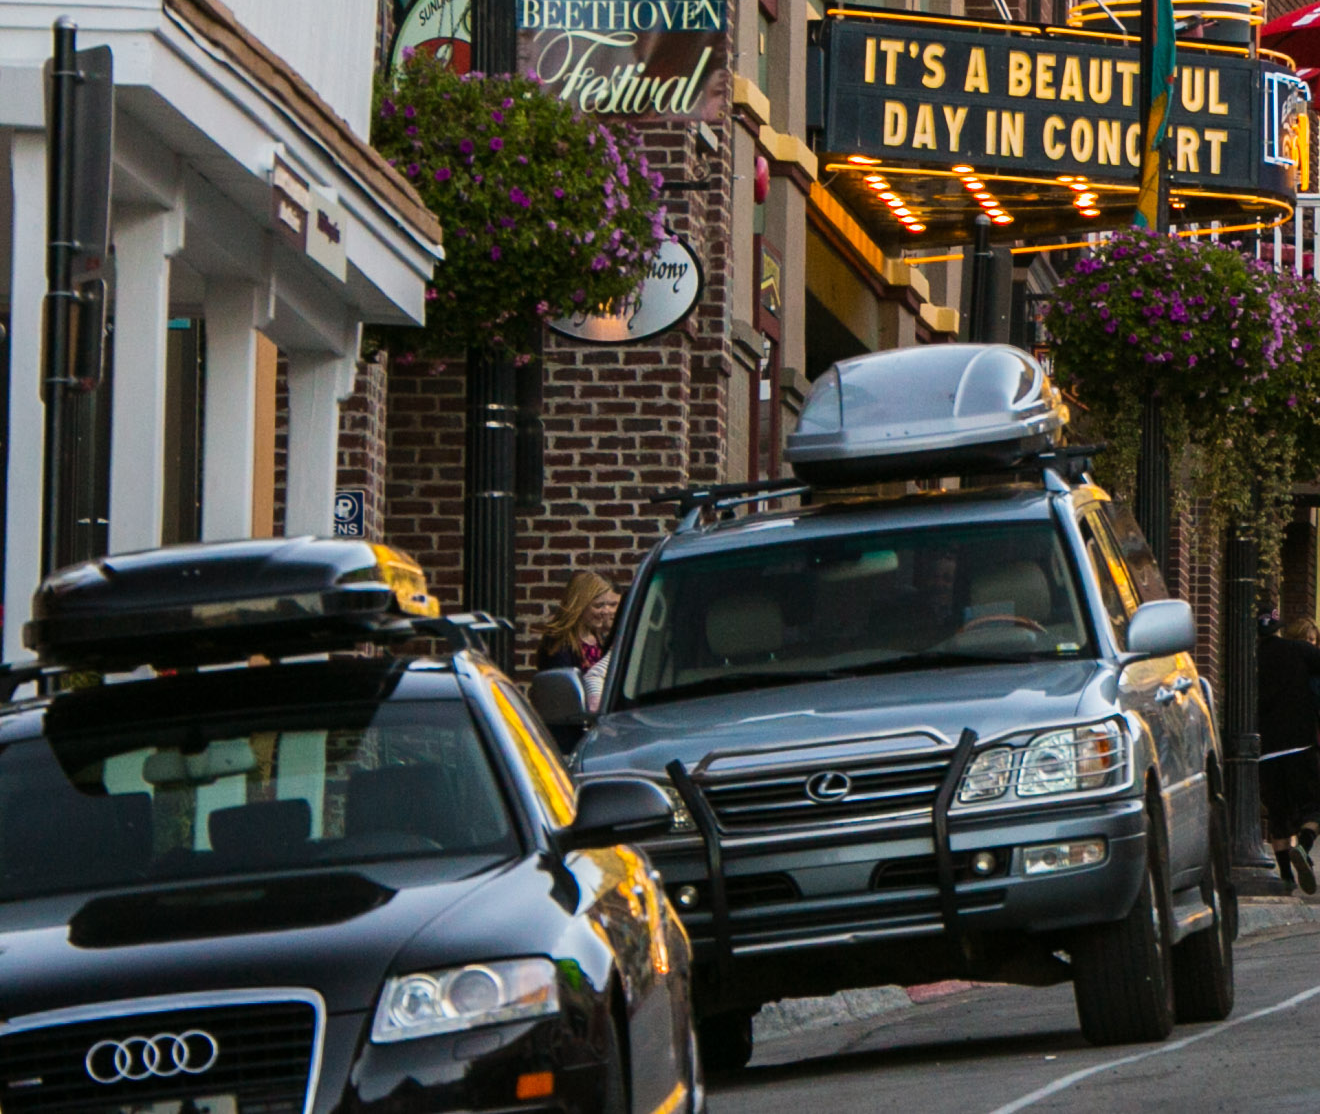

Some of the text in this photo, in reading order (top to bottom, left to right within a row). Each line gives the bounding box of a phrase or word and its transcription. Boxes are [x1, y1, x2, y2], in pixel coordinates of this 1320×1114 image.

[522, 0, 724, 30] BEETHOVEN
[533, 25, 713, 114] Festival
[864, 37, 1229, 115] IT'S A BEAUTUL
[883, 99, 968, 153] DAY
[985, 109, 1025, 158] IN
[1043, 114, 1229, 175] CONCRT
